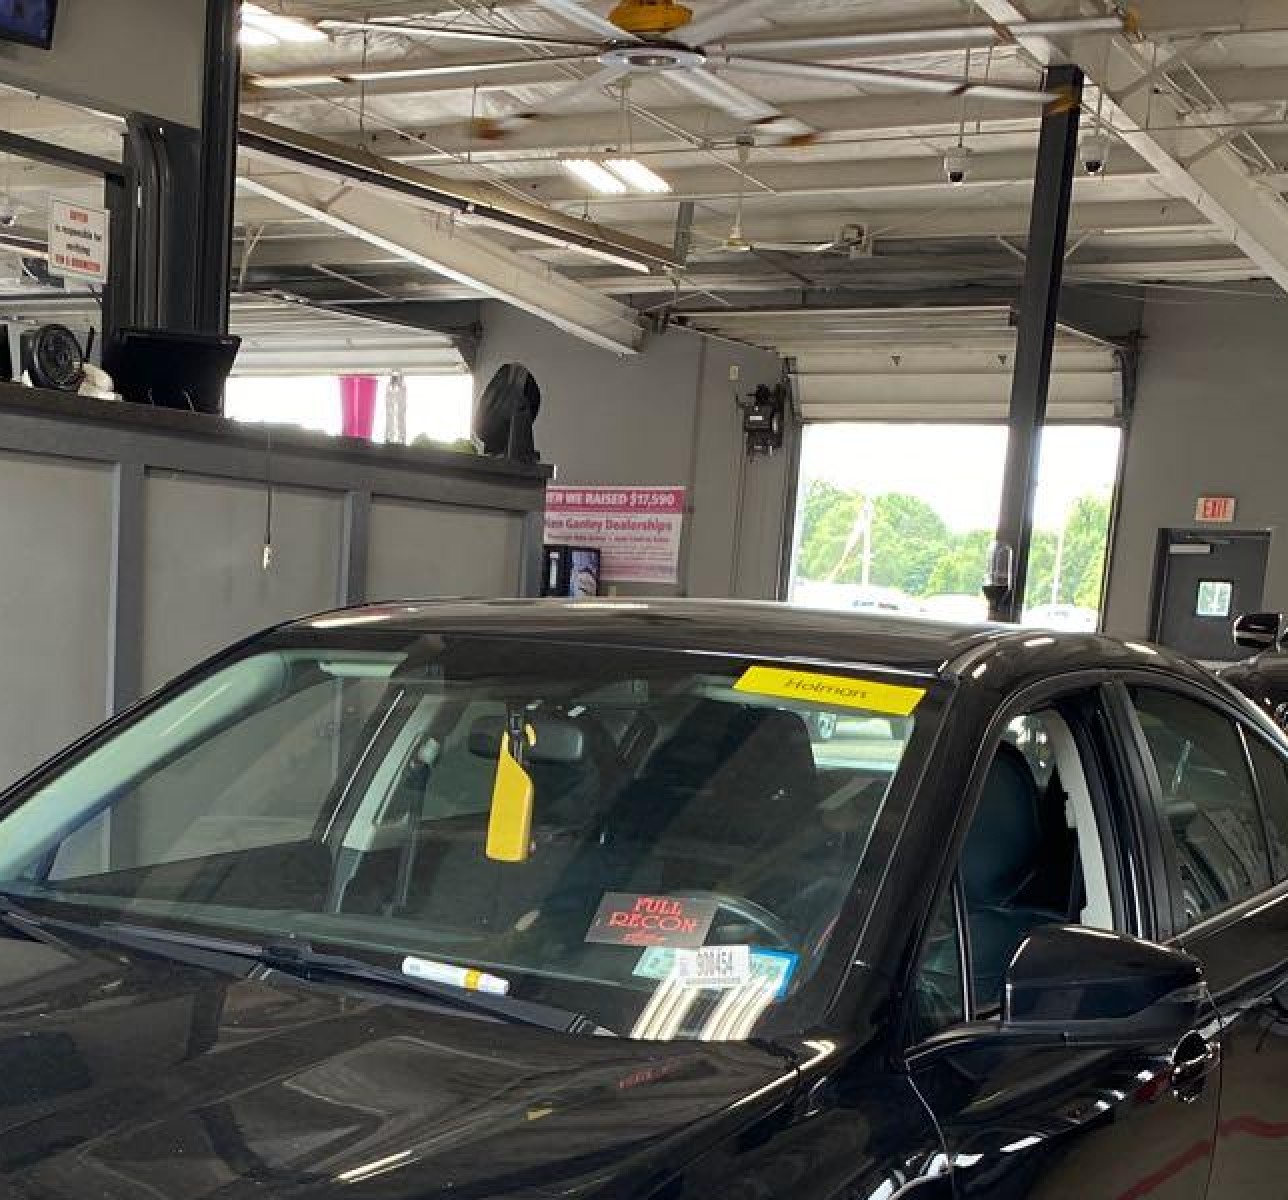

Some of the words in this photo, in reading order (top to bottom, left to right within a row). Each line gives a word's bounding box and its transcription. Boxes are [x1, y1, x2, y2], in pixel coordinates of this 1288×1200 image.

[585, 493, 627, 505] RAISED
[785, 679, 867, 699] Holman
[634, 896, 681, 916] FULL
[609, 911, 697, 933] RECON
